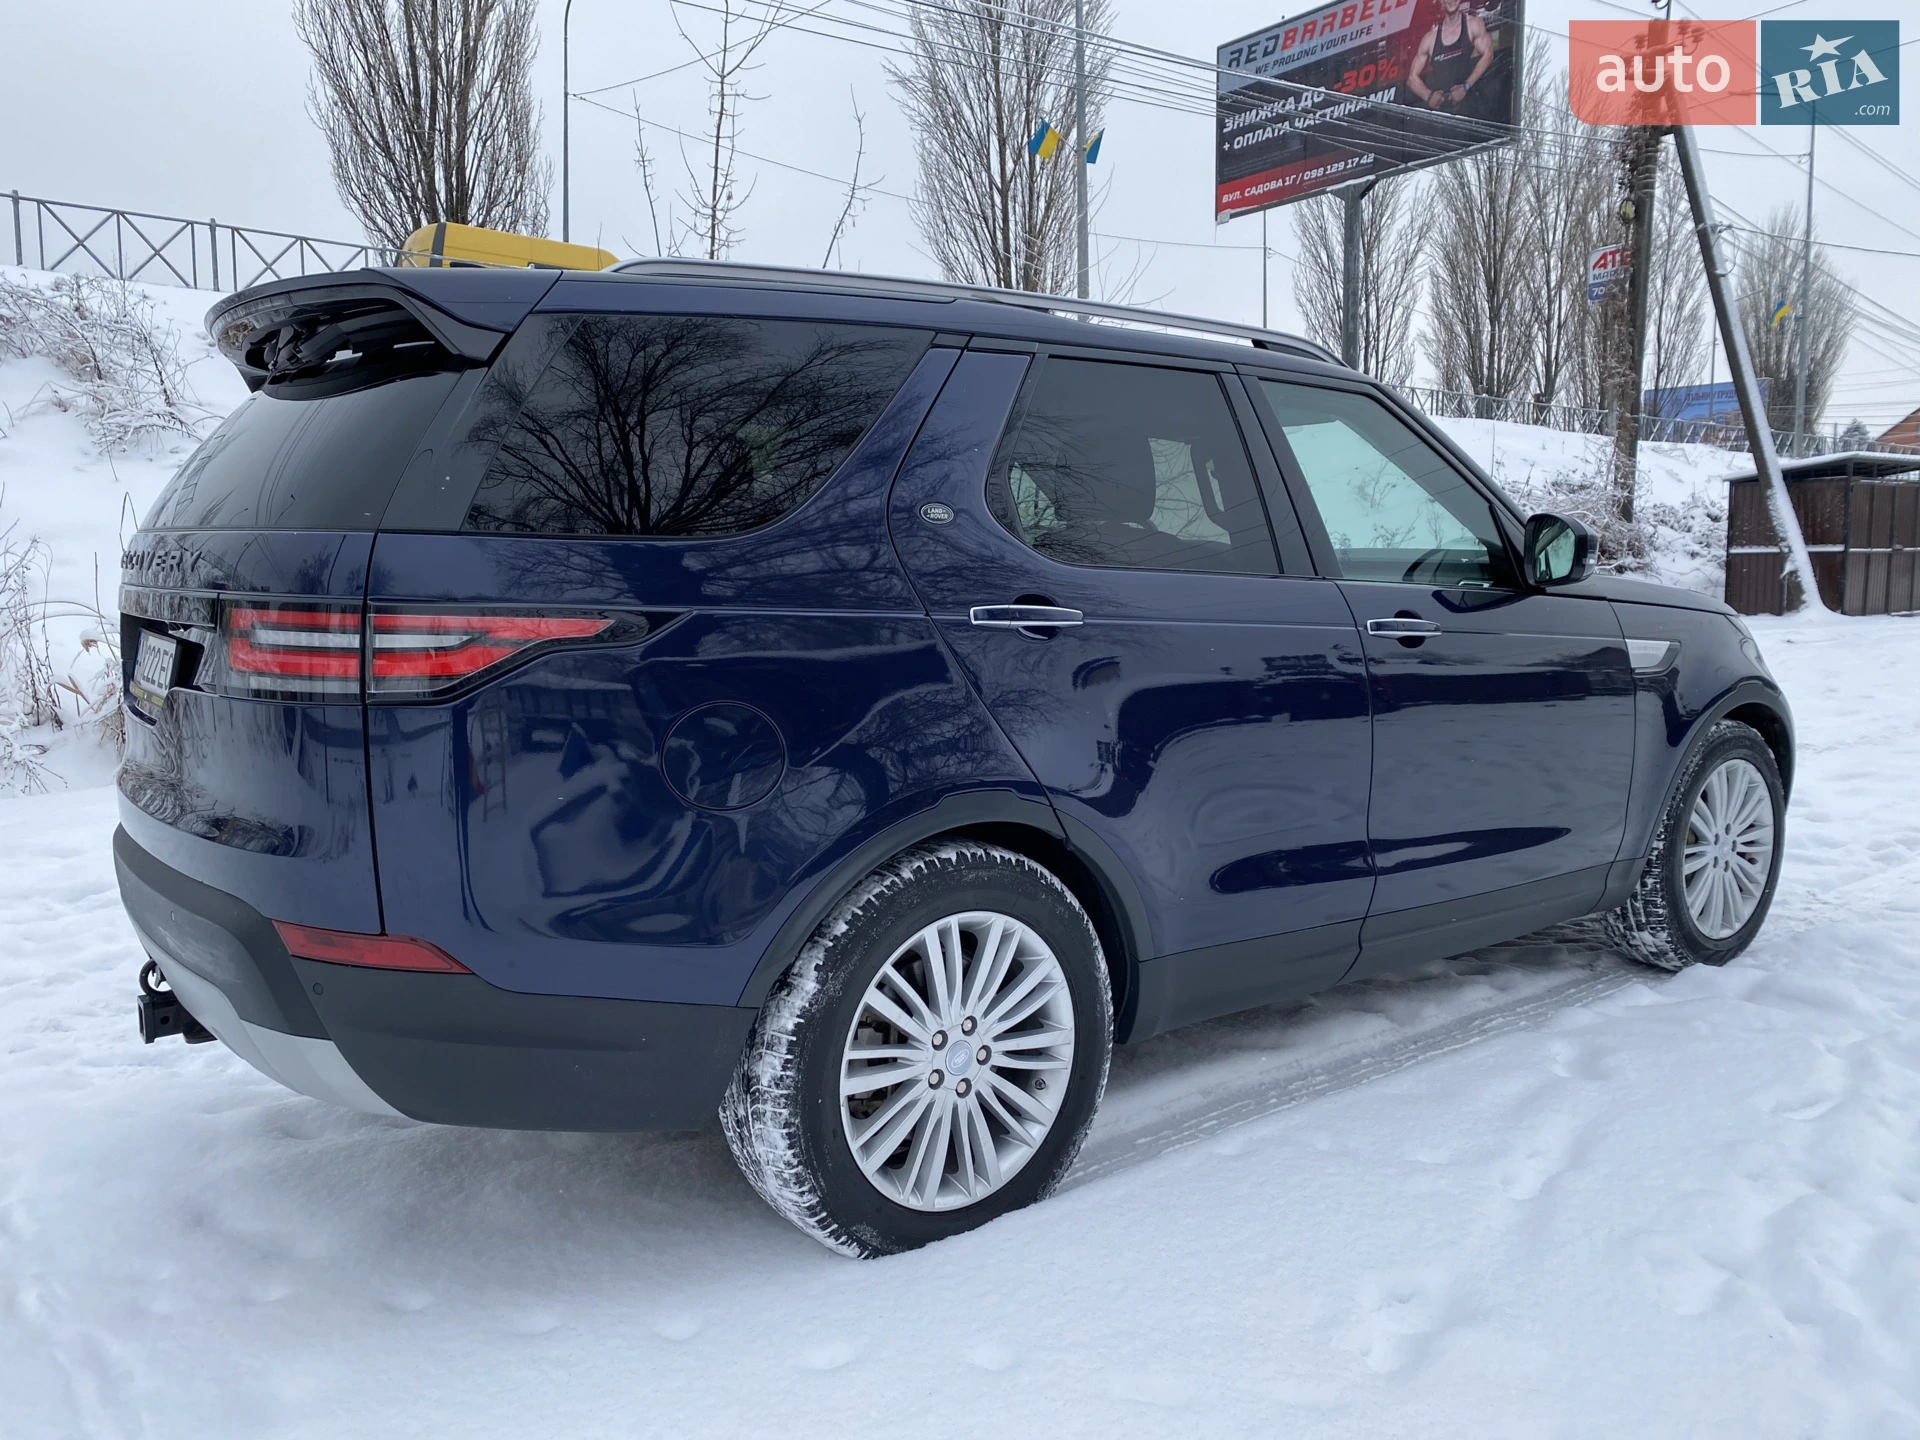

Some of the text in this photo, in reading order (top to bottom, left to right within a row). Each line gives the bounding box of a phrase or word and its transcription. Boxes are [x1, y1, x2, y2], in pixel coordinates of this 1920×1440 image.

[1255, 24, 1373, 75] WE PROLONG YOUR LIFE
[1222, 96, 1296, 133] ЗНИЖКА
[1333, 56, 1399, 94] -30%
[1233, 120, 1291, 150] ОПЛАТА
[1294, 86, 1397, 129] ЧАСТИНАМИ
[1222, 190, 1242, 203] ВУЛ.
[1244, 178, 1284, 197] САДОВА
[1284, 175, 1297, 188] 1Г
[1303, 166, 1325, 180] 098
[1325, 161, 1345, 174] 129
[1346, 157, 1359, 169] 17
[1359, 153, 1375, 165] 42
